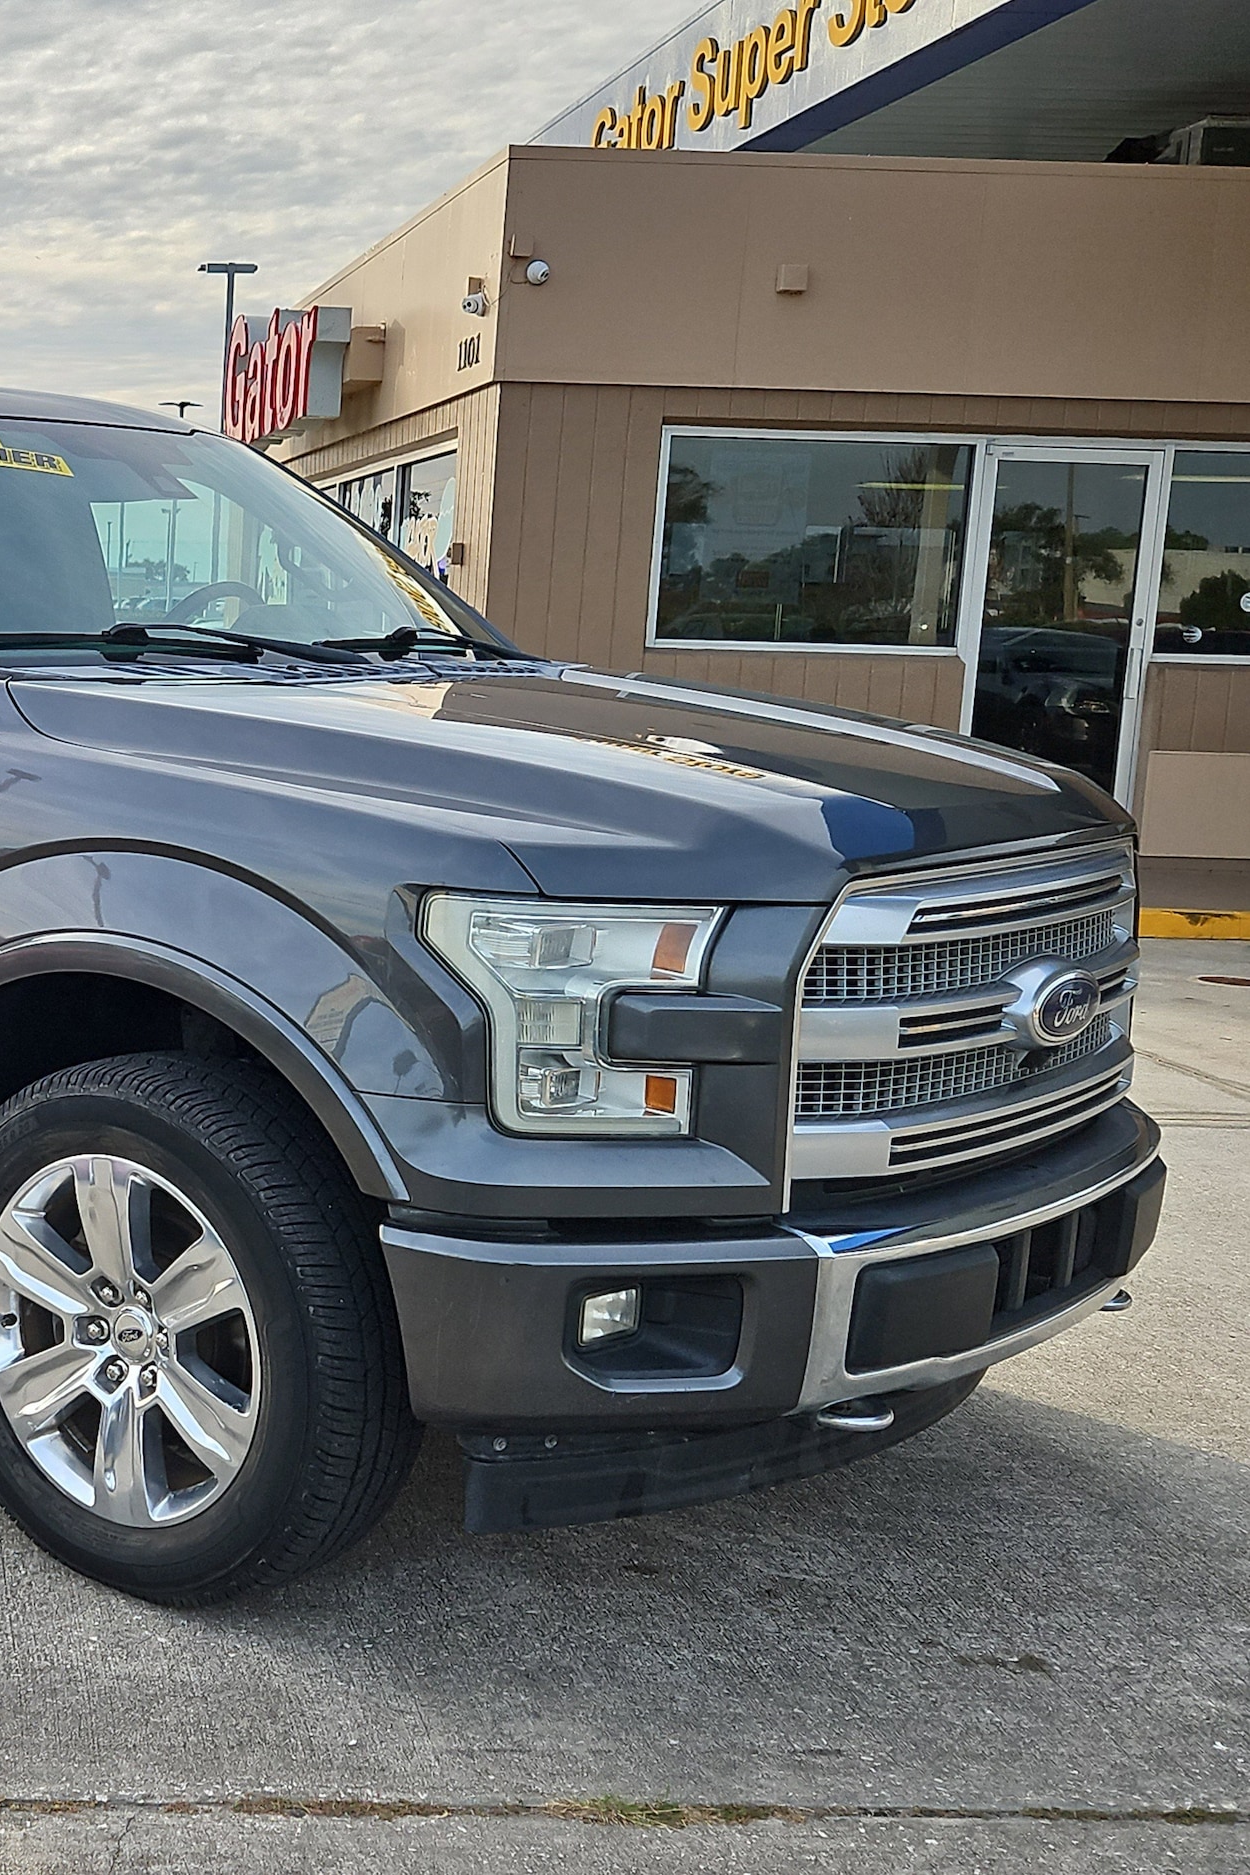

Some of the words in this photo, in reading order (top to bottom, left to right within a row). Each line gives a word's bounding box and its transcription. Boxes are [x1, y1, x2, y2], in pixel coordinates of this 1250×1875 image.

[687, 0, 821, 132] Super
[224, 305, 319, 445] Gator
[456, 332, 482, 373] 1101
[1054, 988, 1092, 1028] Ford
